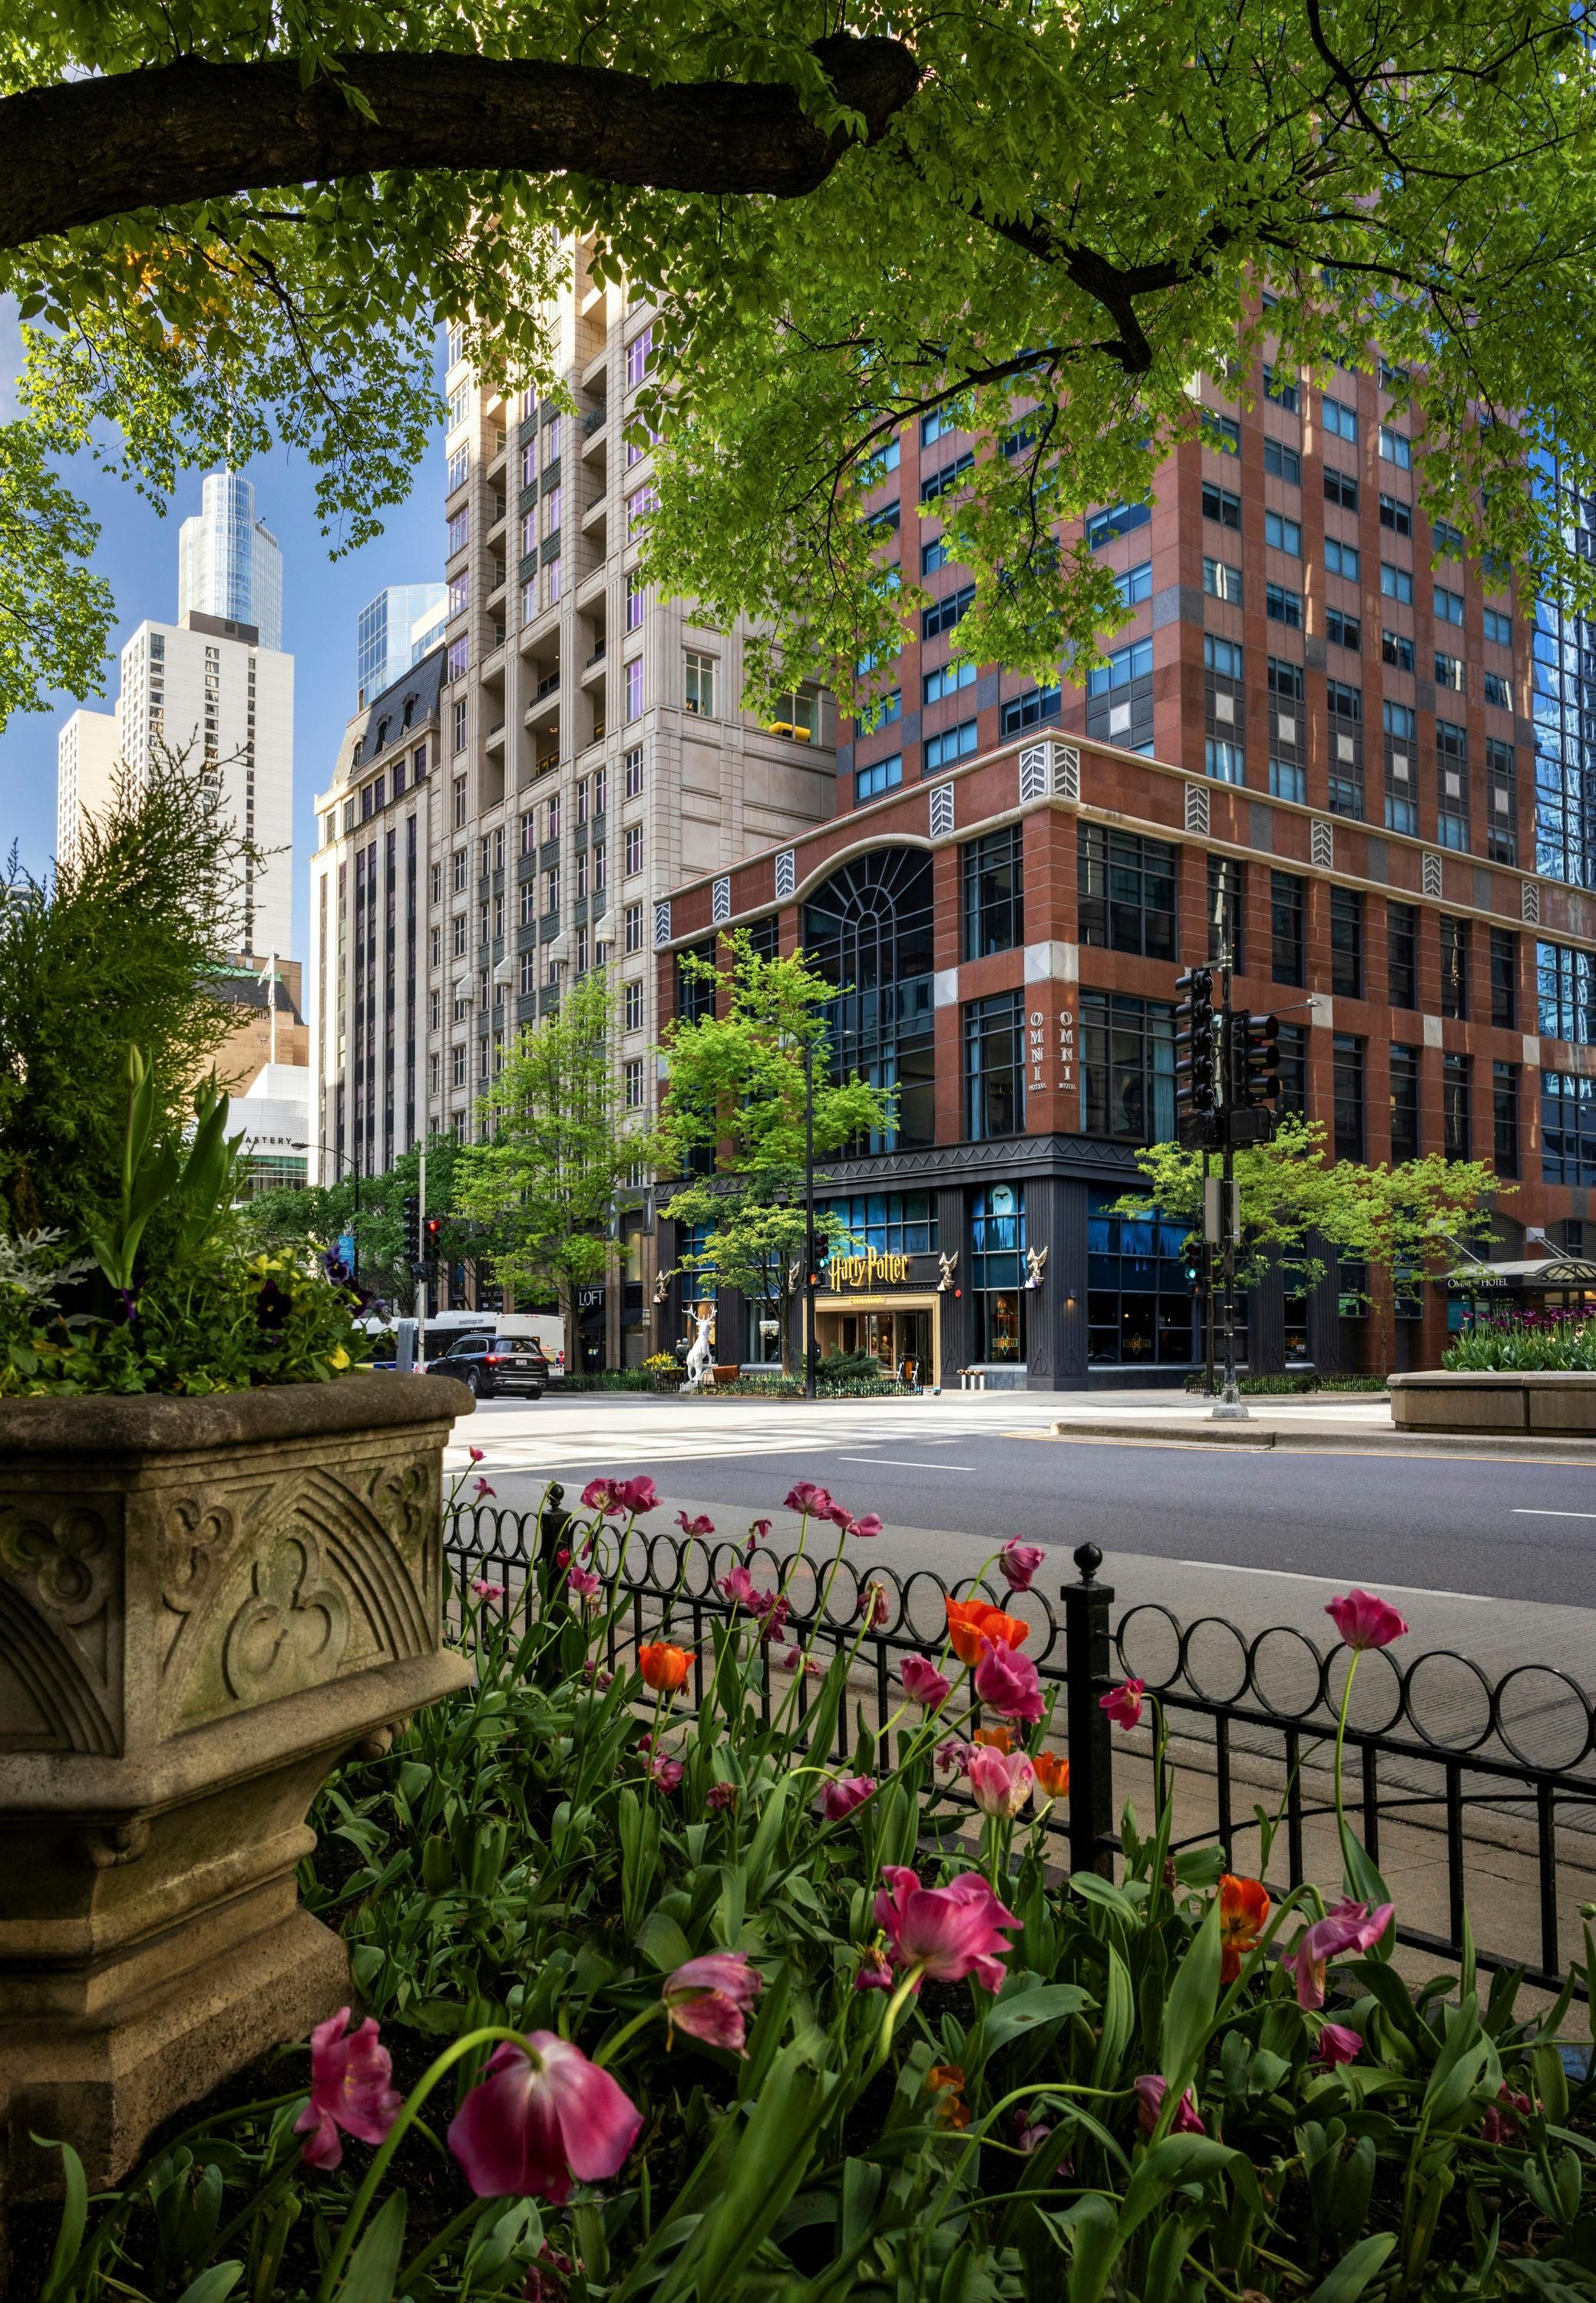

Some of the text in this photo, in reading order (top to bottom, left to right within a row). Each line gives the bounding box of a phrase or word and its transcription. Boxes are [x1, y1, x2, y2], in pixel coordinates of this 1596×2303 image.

[1029, 1012, 1045, 1081] OMNI
[1059, 1011, 1074, 1081] OMNI
[828, 1246, 908, 1293] Harry Potter
[1481, 1277, 1508, 1287] HOTEL
[579, 1290, 603, 1306] LOFT
